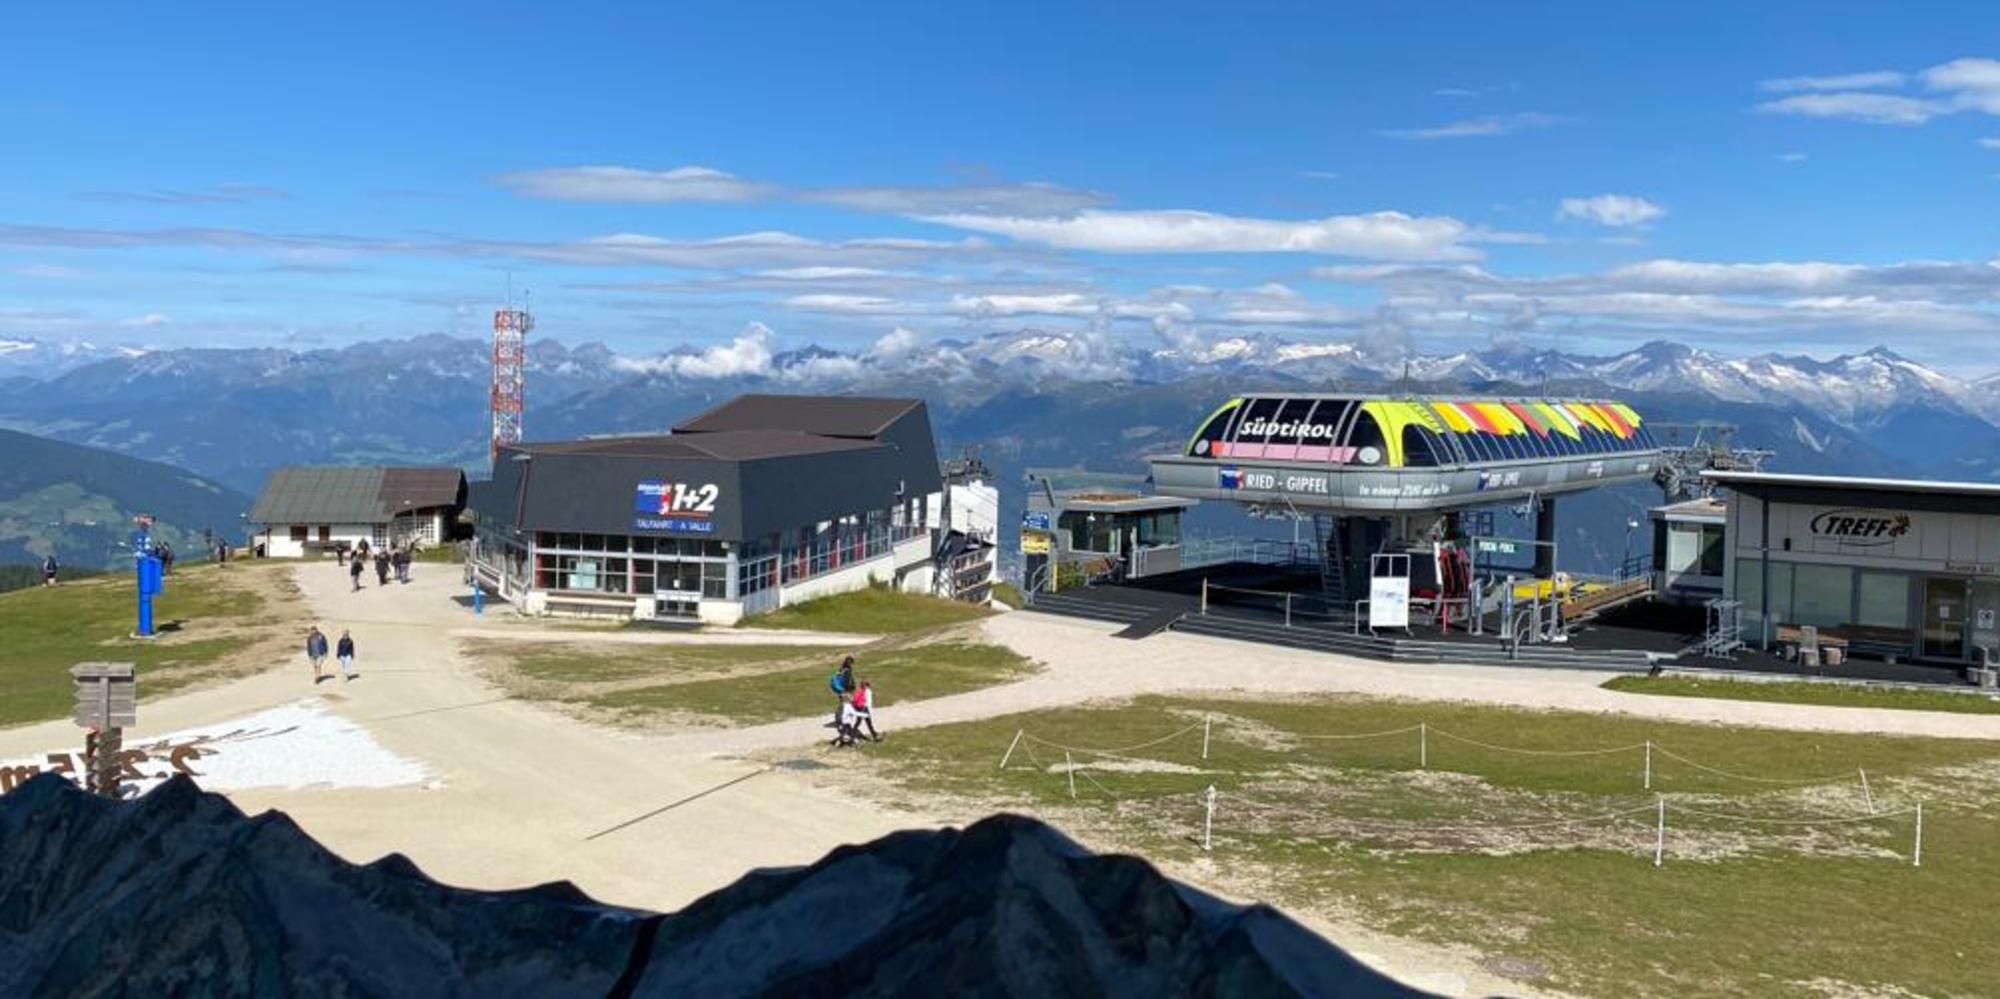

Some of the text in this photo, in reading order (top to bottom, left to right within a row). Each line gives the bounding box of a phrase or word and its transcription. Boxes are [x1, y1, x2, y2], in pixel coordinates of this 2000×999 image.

[1246, 473, 1275, 489] RIED
[1287, 476, 1328, 493] GIPFEL
[672, 483, 719, 512] 1+2
[1824, 517, 1892, 537] TREFF
